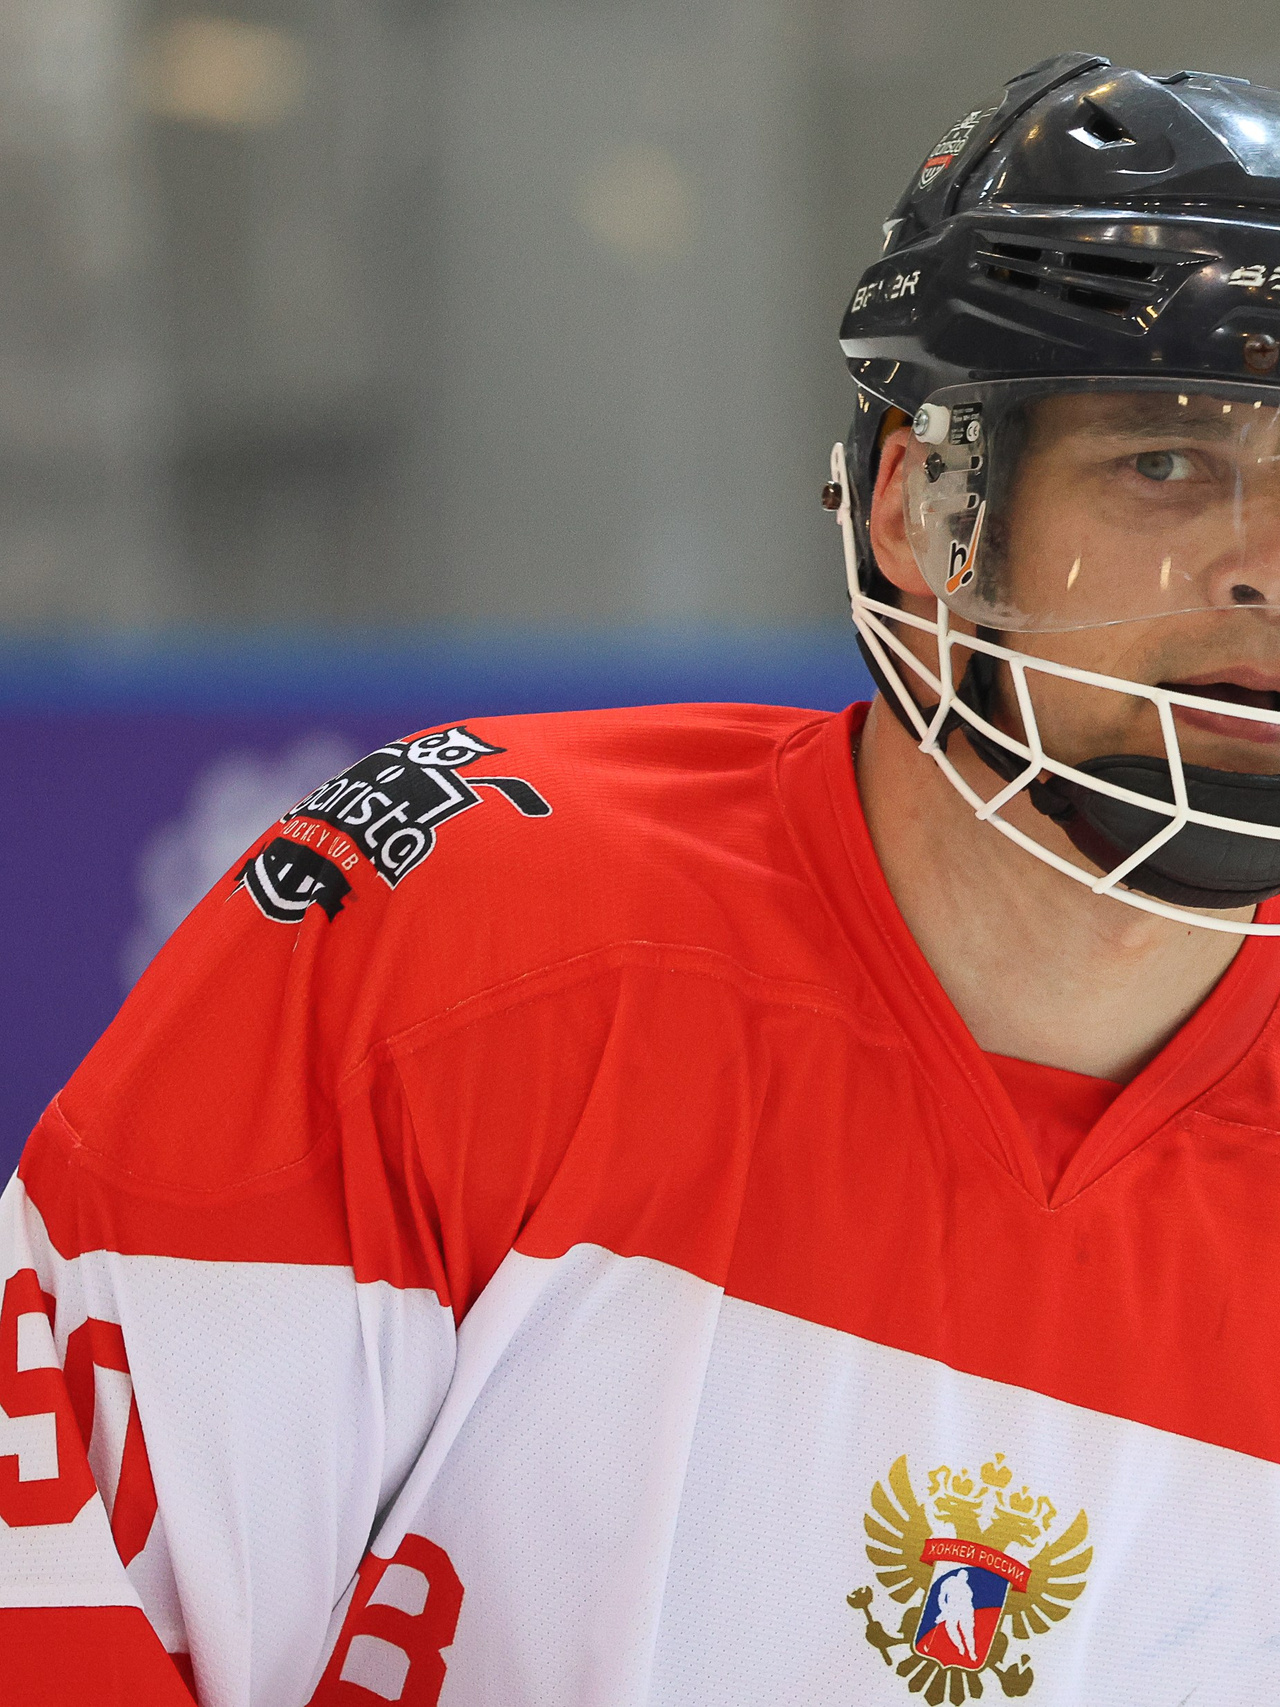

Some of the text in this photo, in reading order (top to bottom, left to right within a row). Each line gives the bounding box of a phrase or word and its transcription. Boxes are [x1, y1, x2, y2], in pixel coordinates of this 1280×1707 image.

[851, 270, 921, 313] BER
[281, 818, 360, 871] OCKEY UB
[928, 1543, 1025, 1582] ХОККЕЙ РОССИИ
